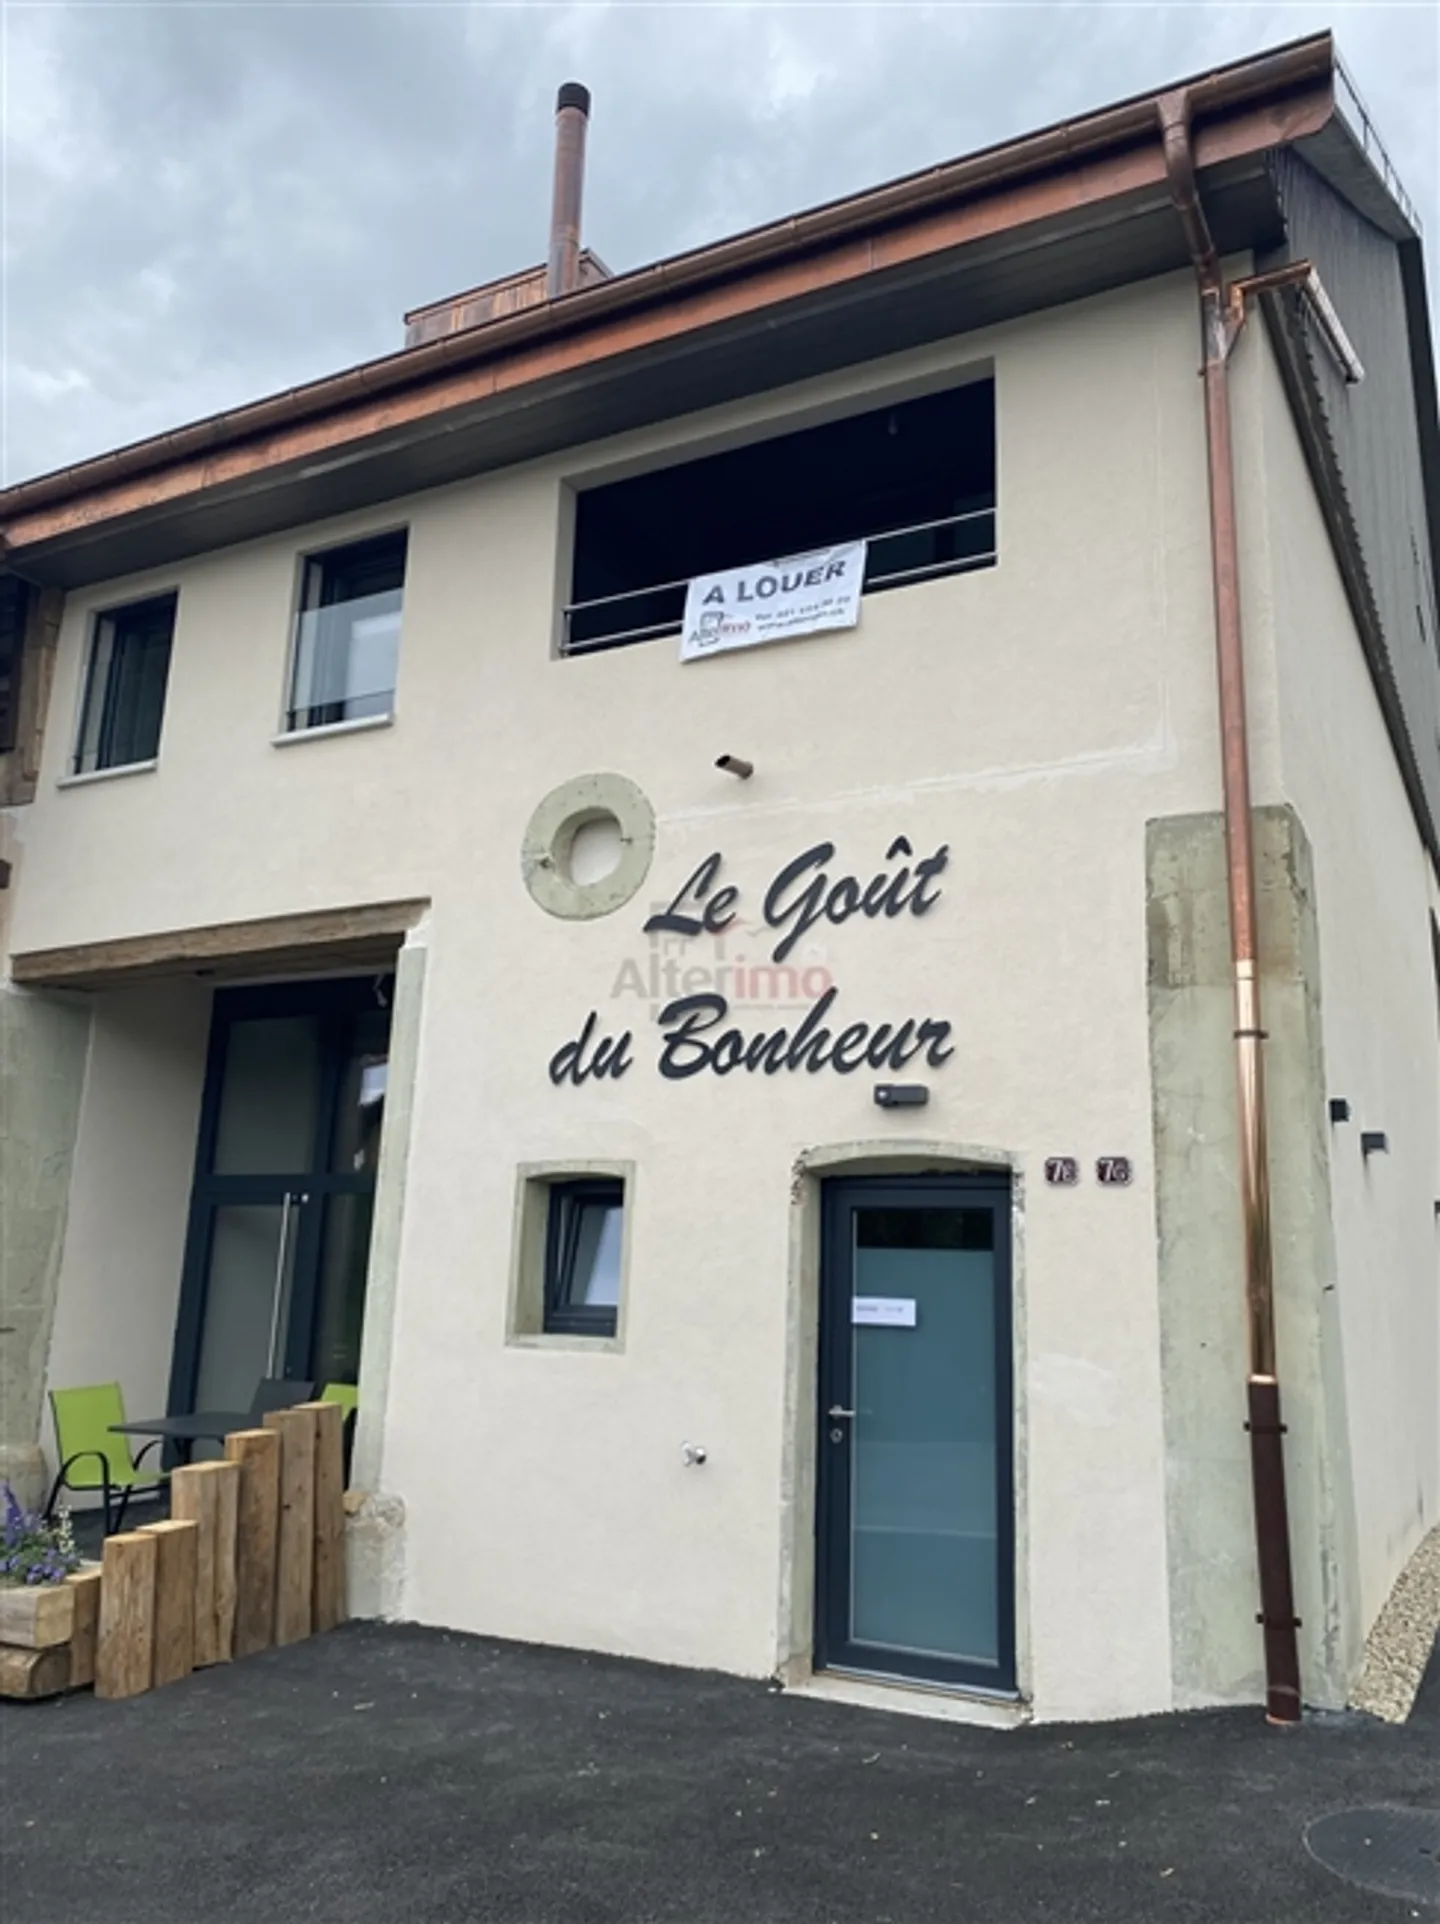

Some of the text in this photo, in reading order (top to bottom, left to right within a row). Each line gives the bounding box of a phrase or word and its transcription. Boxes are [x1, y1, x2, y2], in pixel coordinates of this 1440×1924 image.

[702, 560, 846, 606] A LOUER
[643, 835, 950, 963] Le Goût
[549, 987, 956, 1087] du Bonheur
